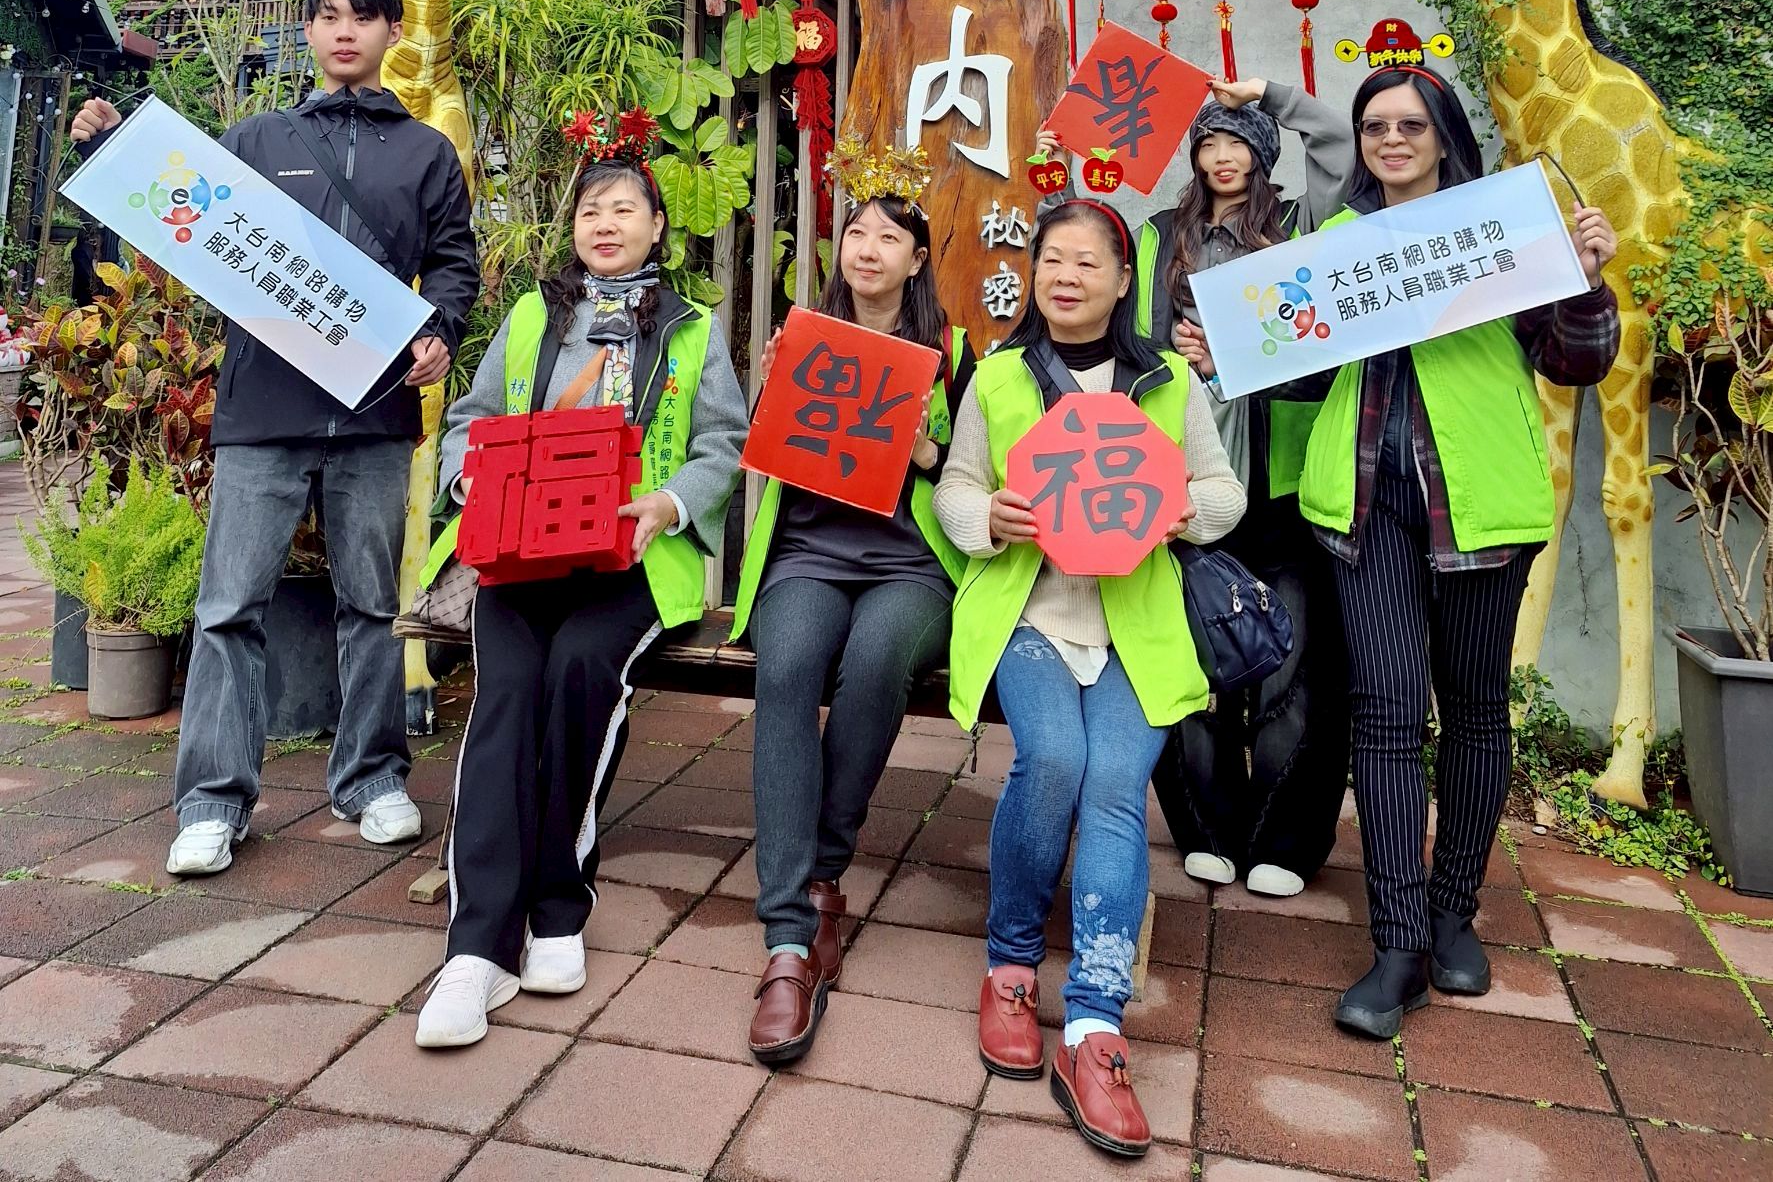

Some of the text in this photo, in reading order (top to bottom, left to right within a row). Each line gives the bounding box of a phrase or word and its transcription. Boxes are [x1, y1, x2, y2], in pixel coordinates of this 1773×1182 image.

[796, 20, 823, 52] 福
[1066, 55, 1166, 158] 春
[170, 187, 190, 205] e
[1036, 168, 1117, 189] 平安 喜乐
[203, 231, 350, 347] 服務人員職業工會
[224, 211, 368, 324] 大台南網路購物
[1327, 219, 1505, 292] 大台南網路購物
[1335, 248, 1517, 322] 服務人員職業工會
[1278, 302, 1295, 320] e
[785, 341, 914, 478] 福
[456, 404, 630, 568] 福
[1030, 408, 1164, 540] 福
